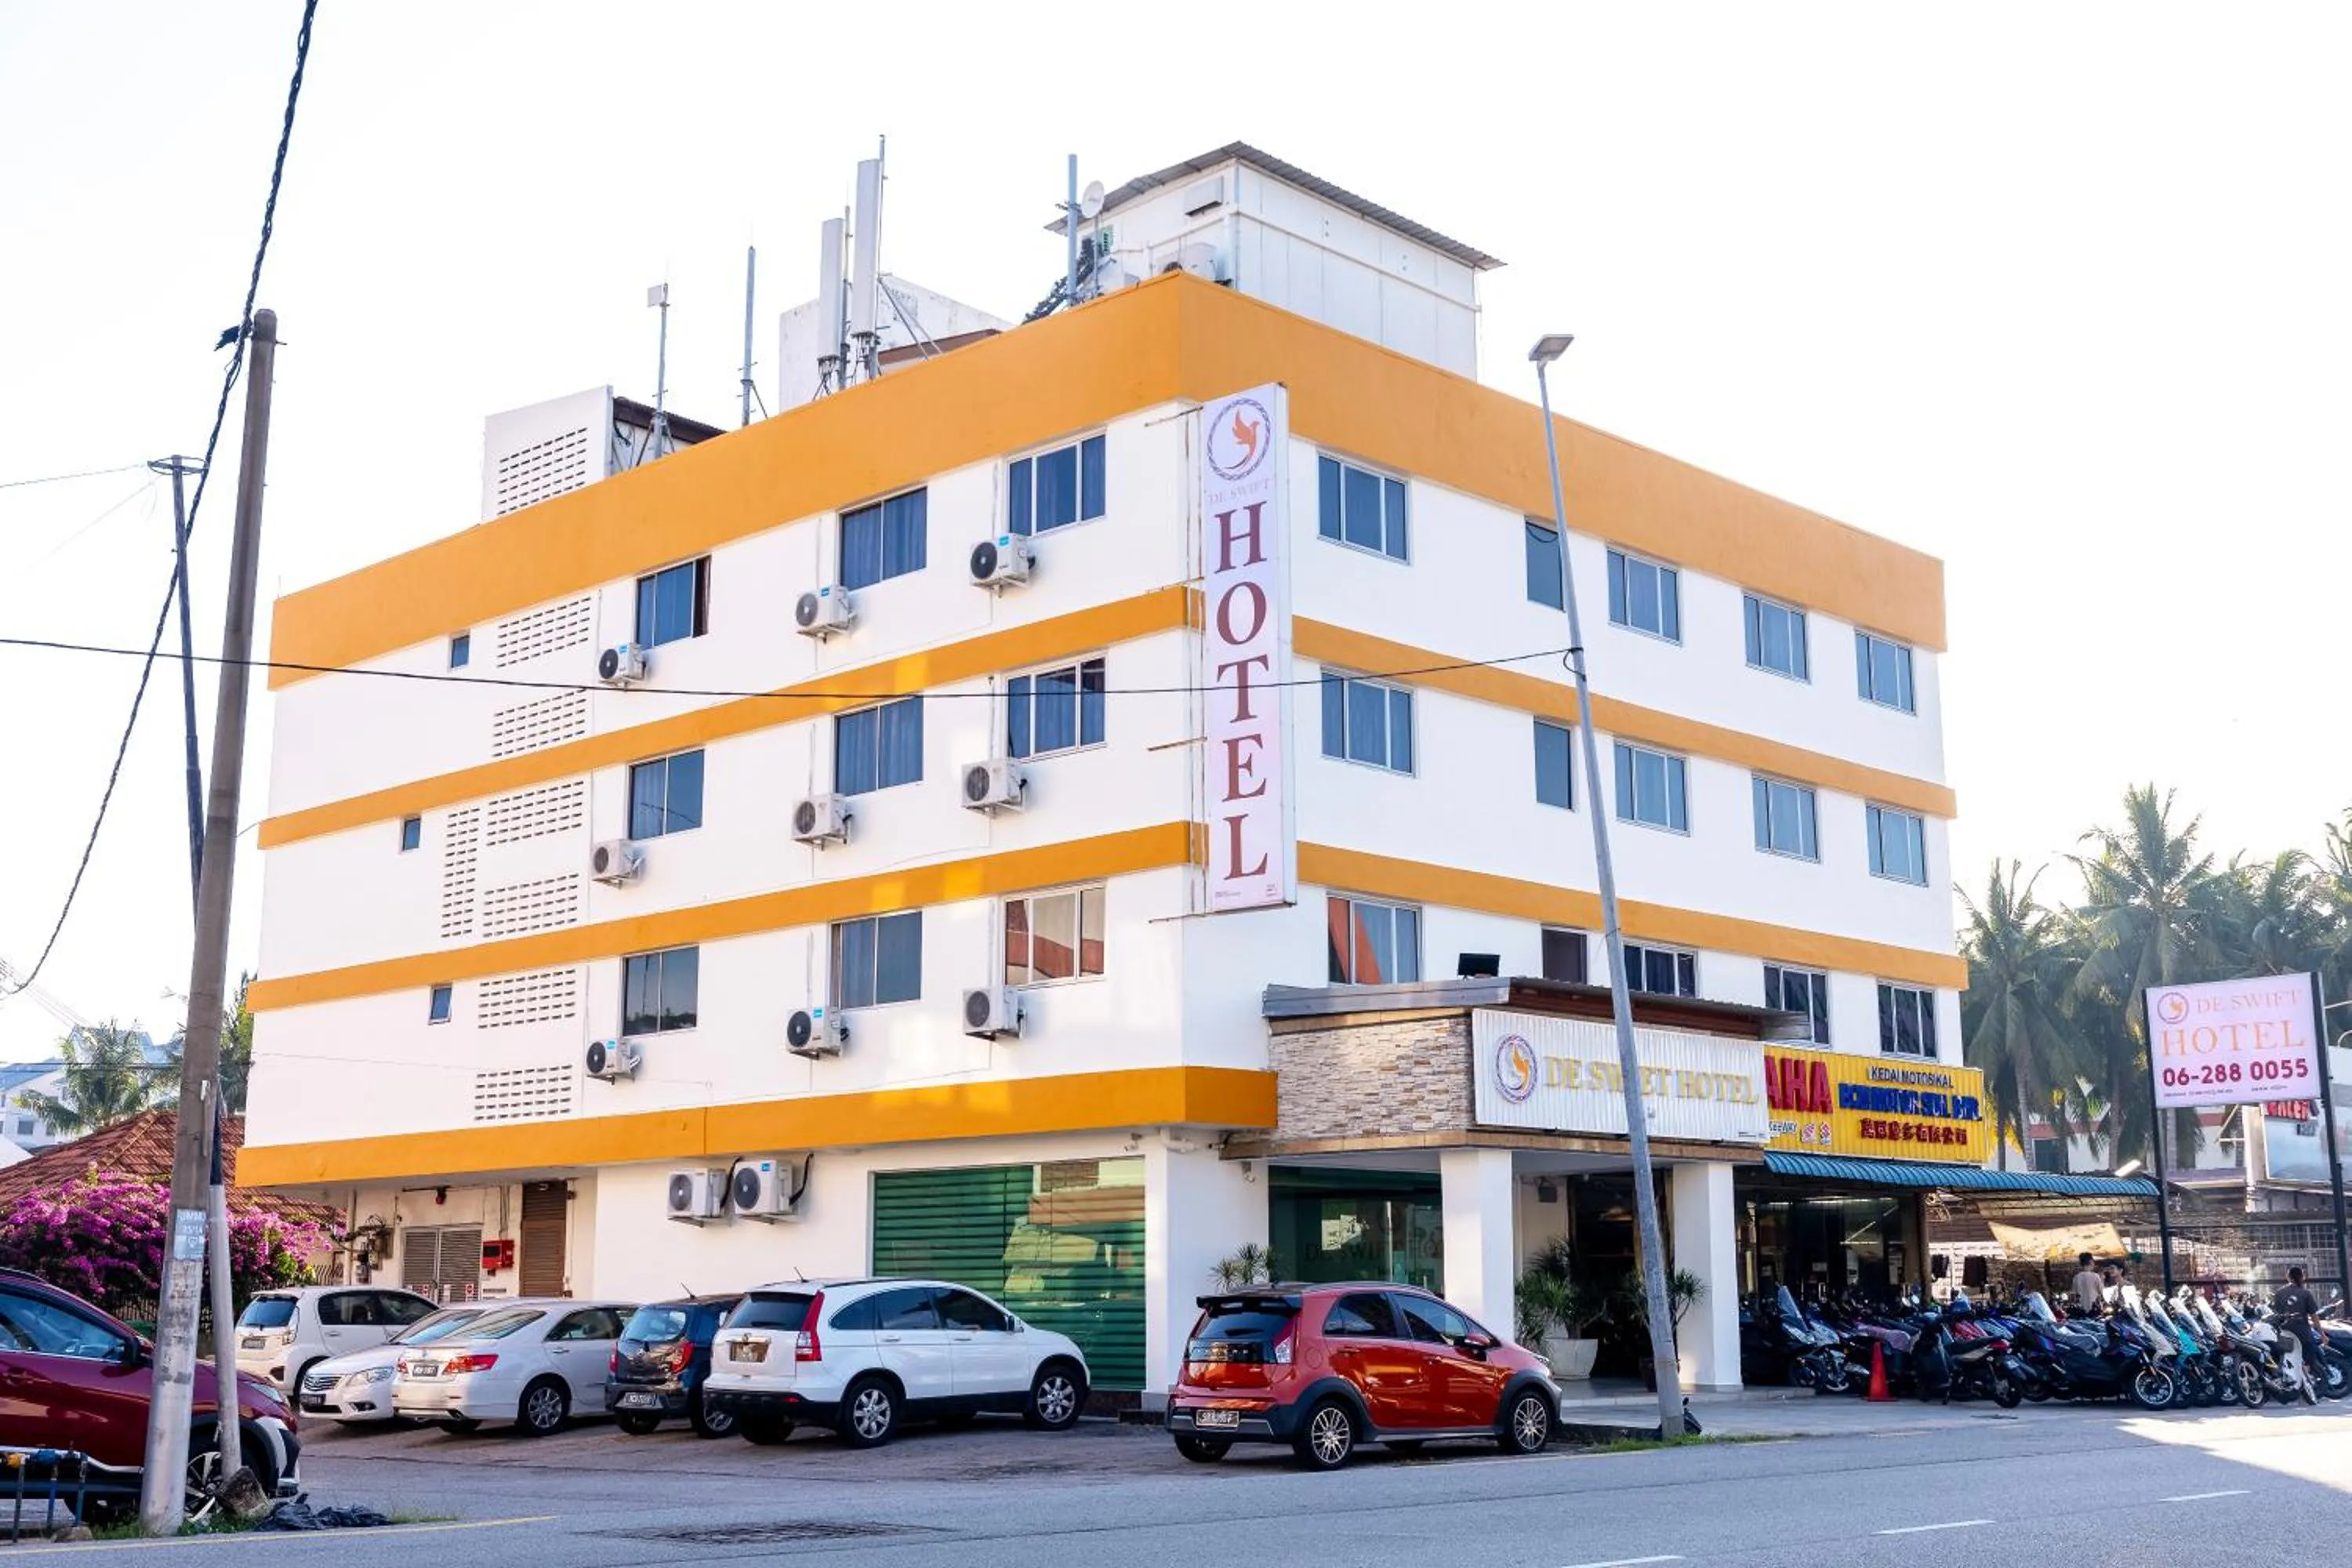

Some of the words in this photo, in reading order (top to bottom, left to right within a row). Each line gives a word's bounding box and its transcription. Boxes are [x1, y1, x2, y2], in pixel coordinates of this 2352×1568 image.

[1214, 499, 1269, 882] HOTEL
[2197, 996, 2223, 1014] DE
[2230, 988, 2303, 1011] SWIFT
[2161, 1019, 2307, 1057] HOTEL
[1543, 1055, 1582, 1089] DE
[1585, 1060, 1671, 1096] SWFT
[1676, 1069, 1756, 1105] HOTEL
[1871, 1065, 1900, 1082] KEDAI
[1901, 1069, 1955, 1088] MOTOSIKAL
[2162, 1062, 2242, 1087] 06-288
[2249, 1058, 2309, 1081] 0055
